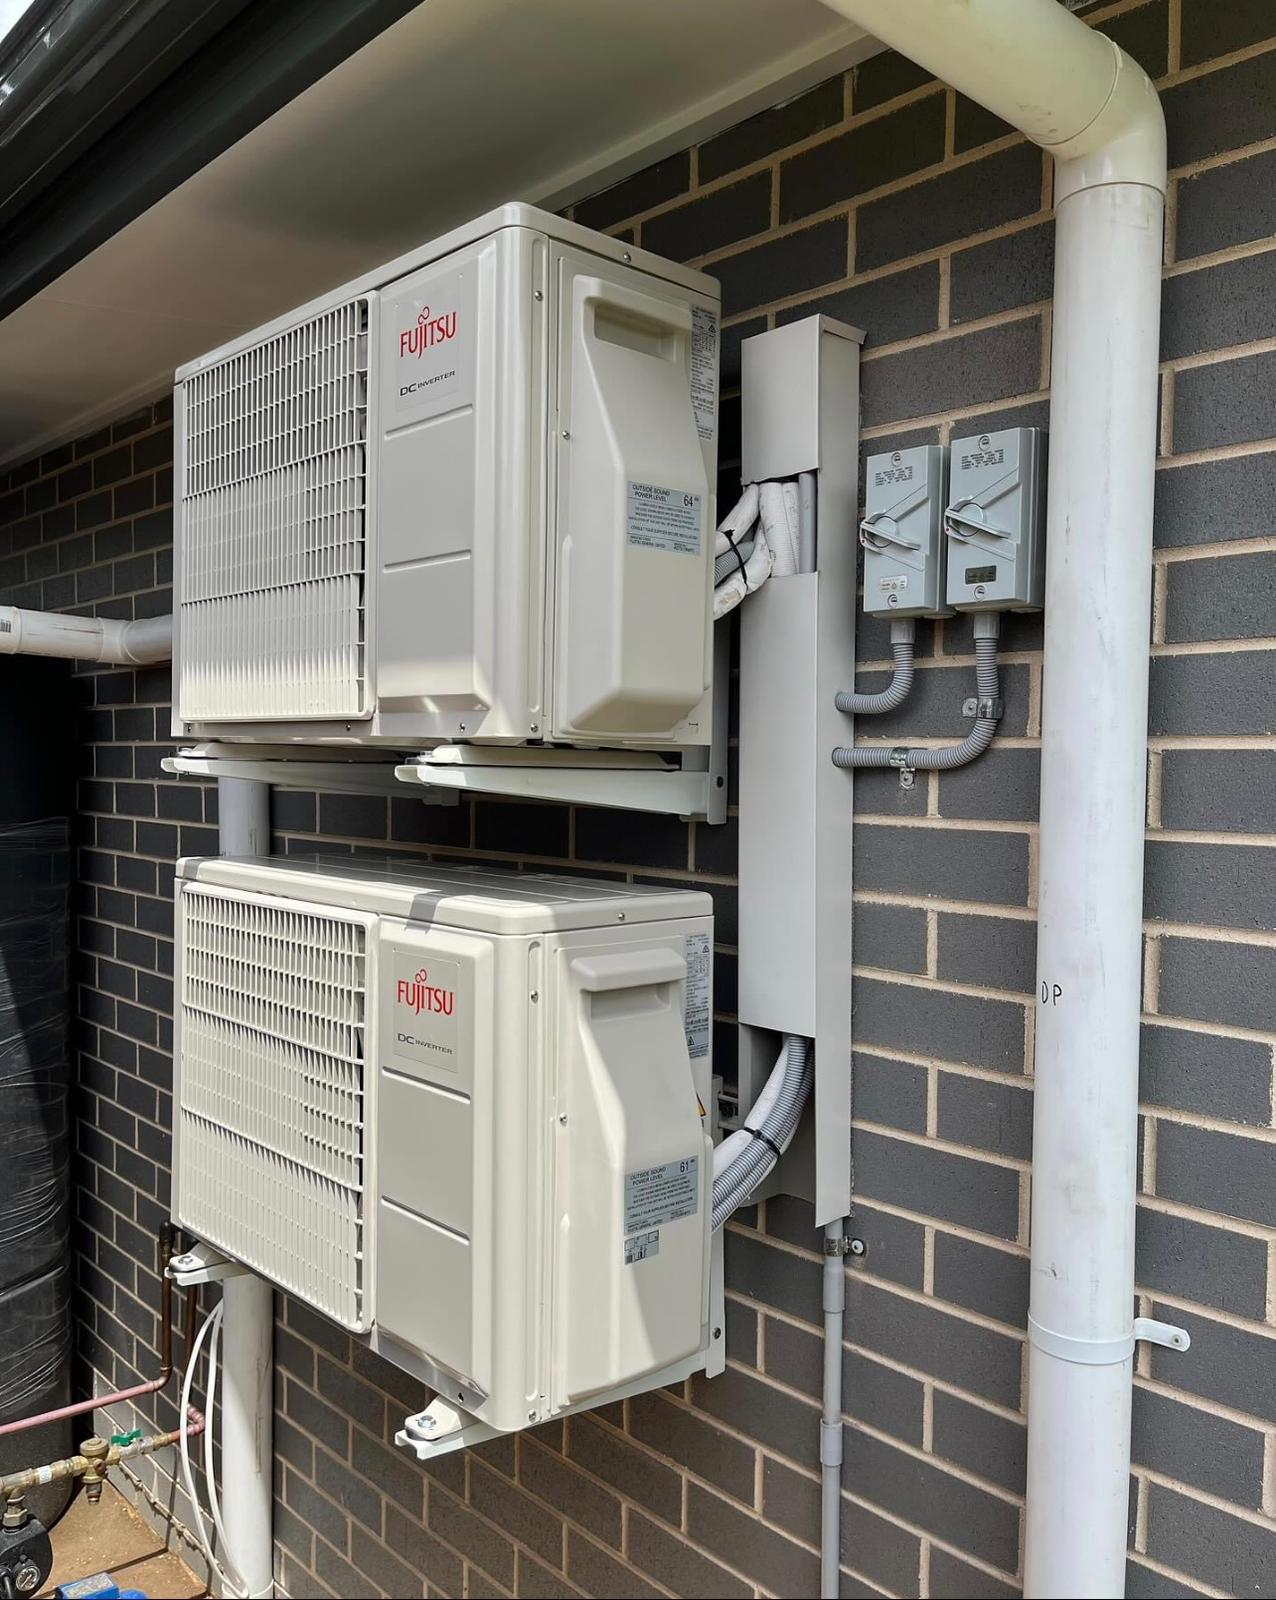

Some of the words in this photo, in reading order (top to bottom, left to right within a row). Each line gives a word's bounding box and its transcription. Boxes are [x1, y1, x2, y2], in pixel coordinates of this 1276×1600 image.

[400, 307, 456, 359] FUJITSU
[400, 383, 417, 396] DC
[417, 370, 456, 389] INVERTER
[632, 484, 653, 493] OUTSIDE
[654, 487, 671, 496] SOUND
[634, 491, 653, 499] POWER
[653, 494, 667, 502] LEVEL
[683, 494, 693, 507] 64
[397, 968, 454, 1015] FUJITSU
[397, 1033, 415, 1045] DC
[415, 1039, 453, 1055] INVERTER
[680, 1160, 689, 1173] 61
